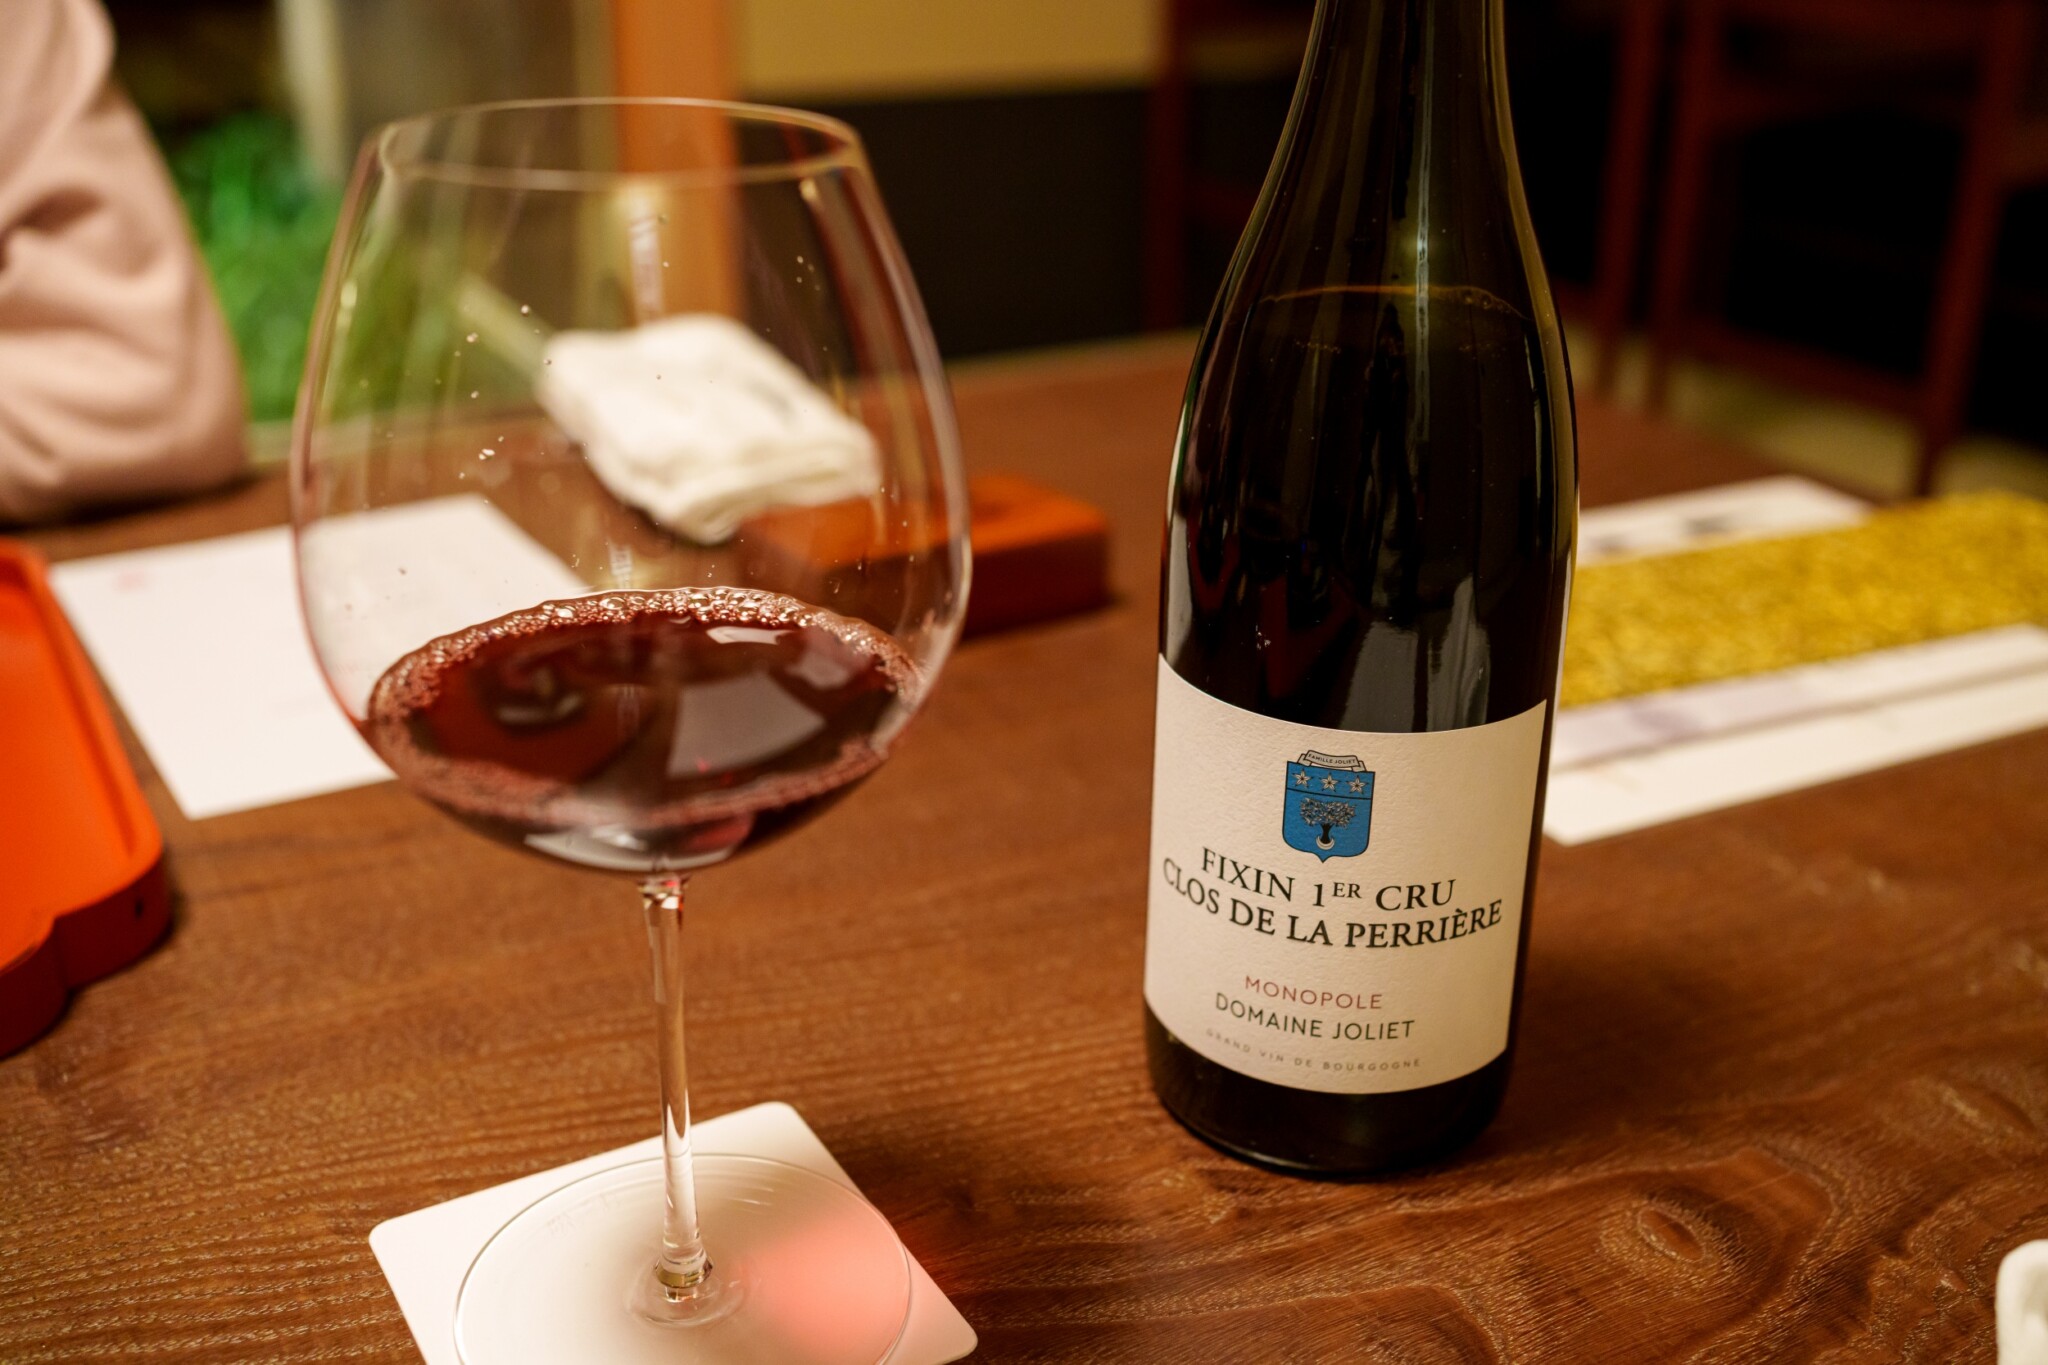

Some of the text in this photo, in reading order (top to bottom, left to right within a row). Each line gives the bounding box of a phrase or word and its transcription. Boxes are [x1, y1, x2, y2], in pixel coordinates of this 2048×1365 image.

[1163, 857, 1502, 948] CLOS DE LA PERRIÈRE
[1202, 848, 1456, 911] FIXIN 1ER CRU
[1216, 992, 1415, 1041] DOMAINE JOLIET
[1245, 975, 1383, 1010] MONOPOLE
[1206, 1028, 1421, 1072] GRAND VIN DE BOURGOGNE
